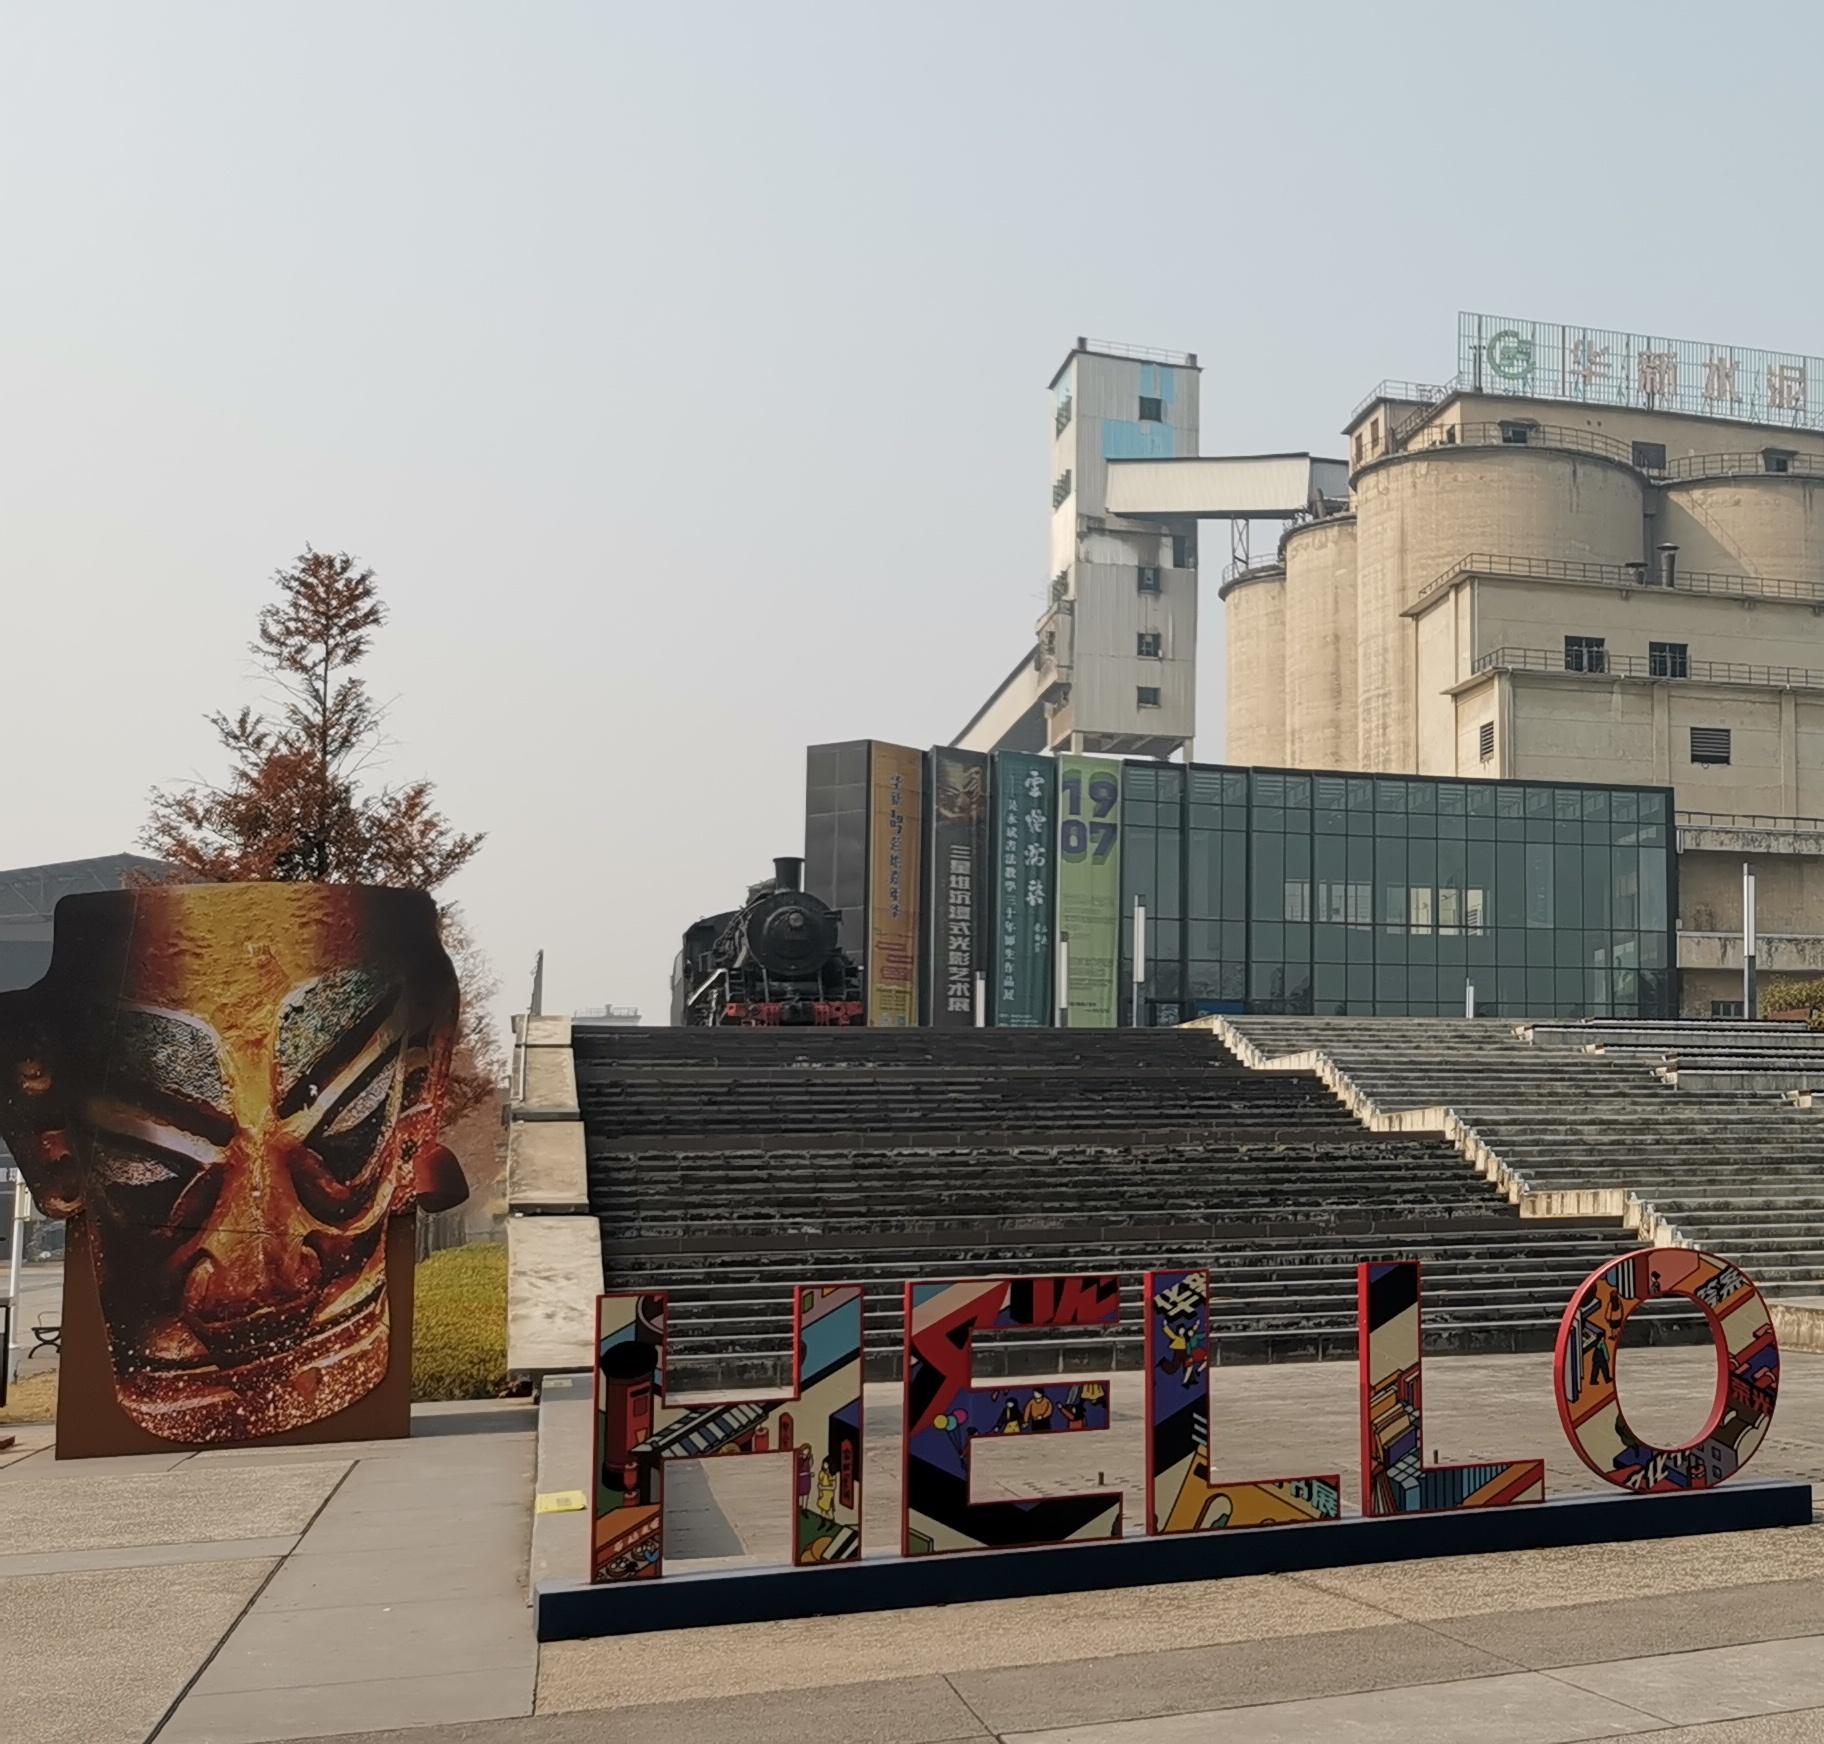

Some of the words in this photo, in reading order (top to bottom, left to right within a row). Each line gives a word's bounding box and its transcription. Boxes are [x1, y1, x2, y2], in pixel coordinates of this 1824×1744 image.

[1569, 338, 1807, 411] 华新水泥
[947, 844, 971, 1012] 三星堆沉浸式光影艺术展
[590, 1247, 1780, 1584] HELLO
